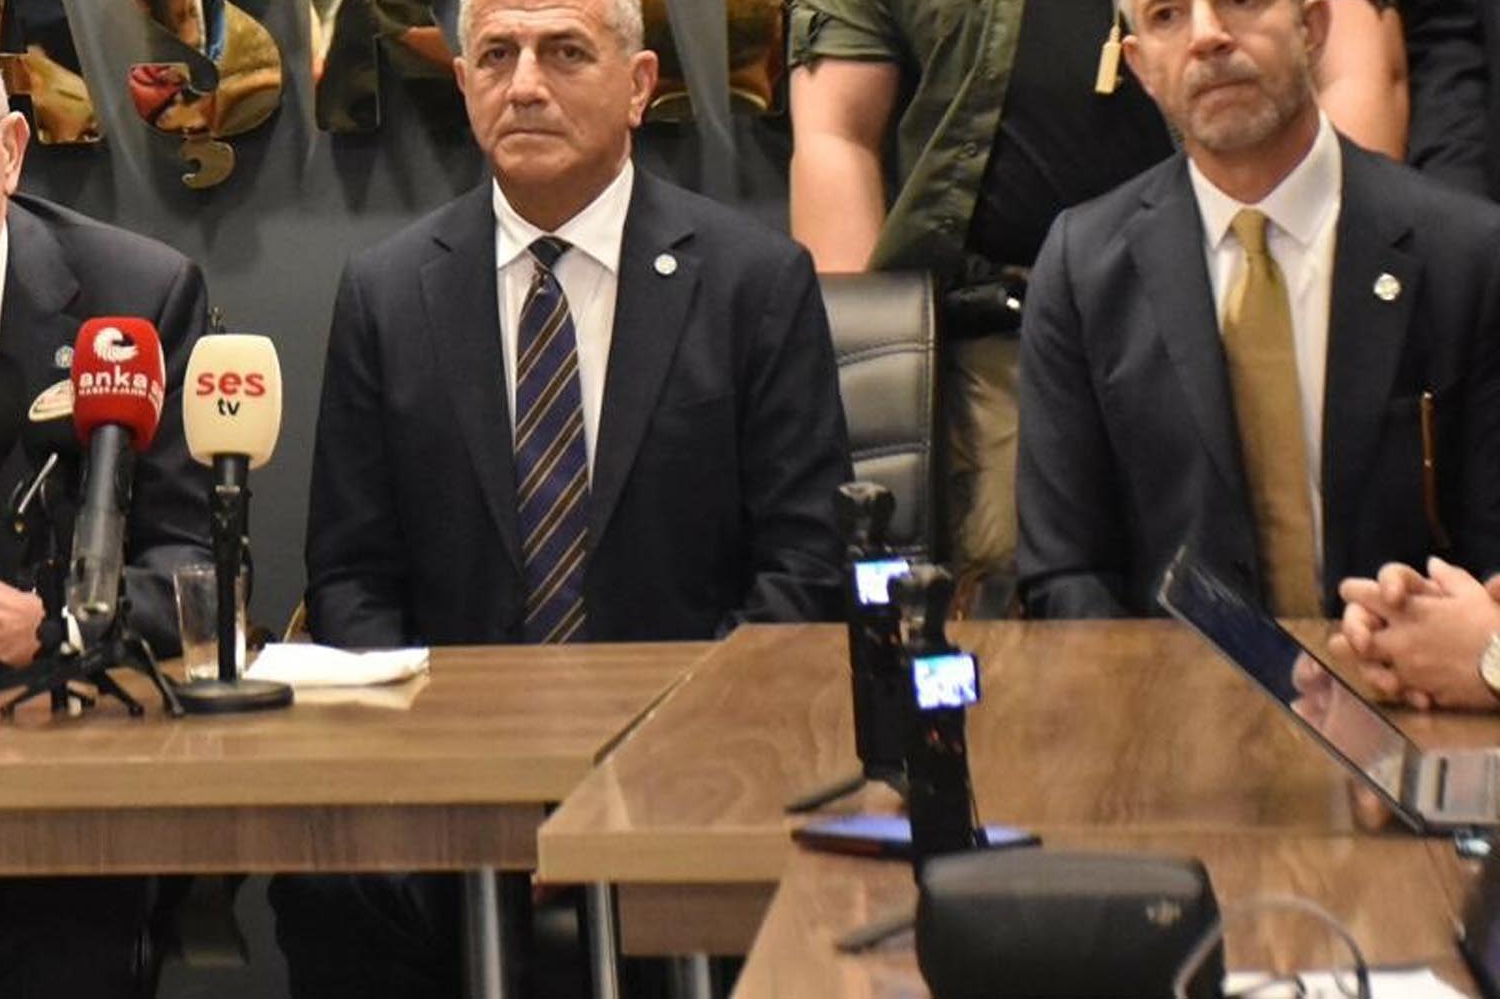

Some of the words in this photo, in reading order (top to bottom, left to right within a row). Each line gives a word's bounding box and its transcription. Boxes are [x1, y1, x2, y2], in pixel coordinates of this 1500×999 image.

[79, 363, 148, 390] anka
[196, 371, 266, 397] ses
[217, 397, 241, 416] tv
